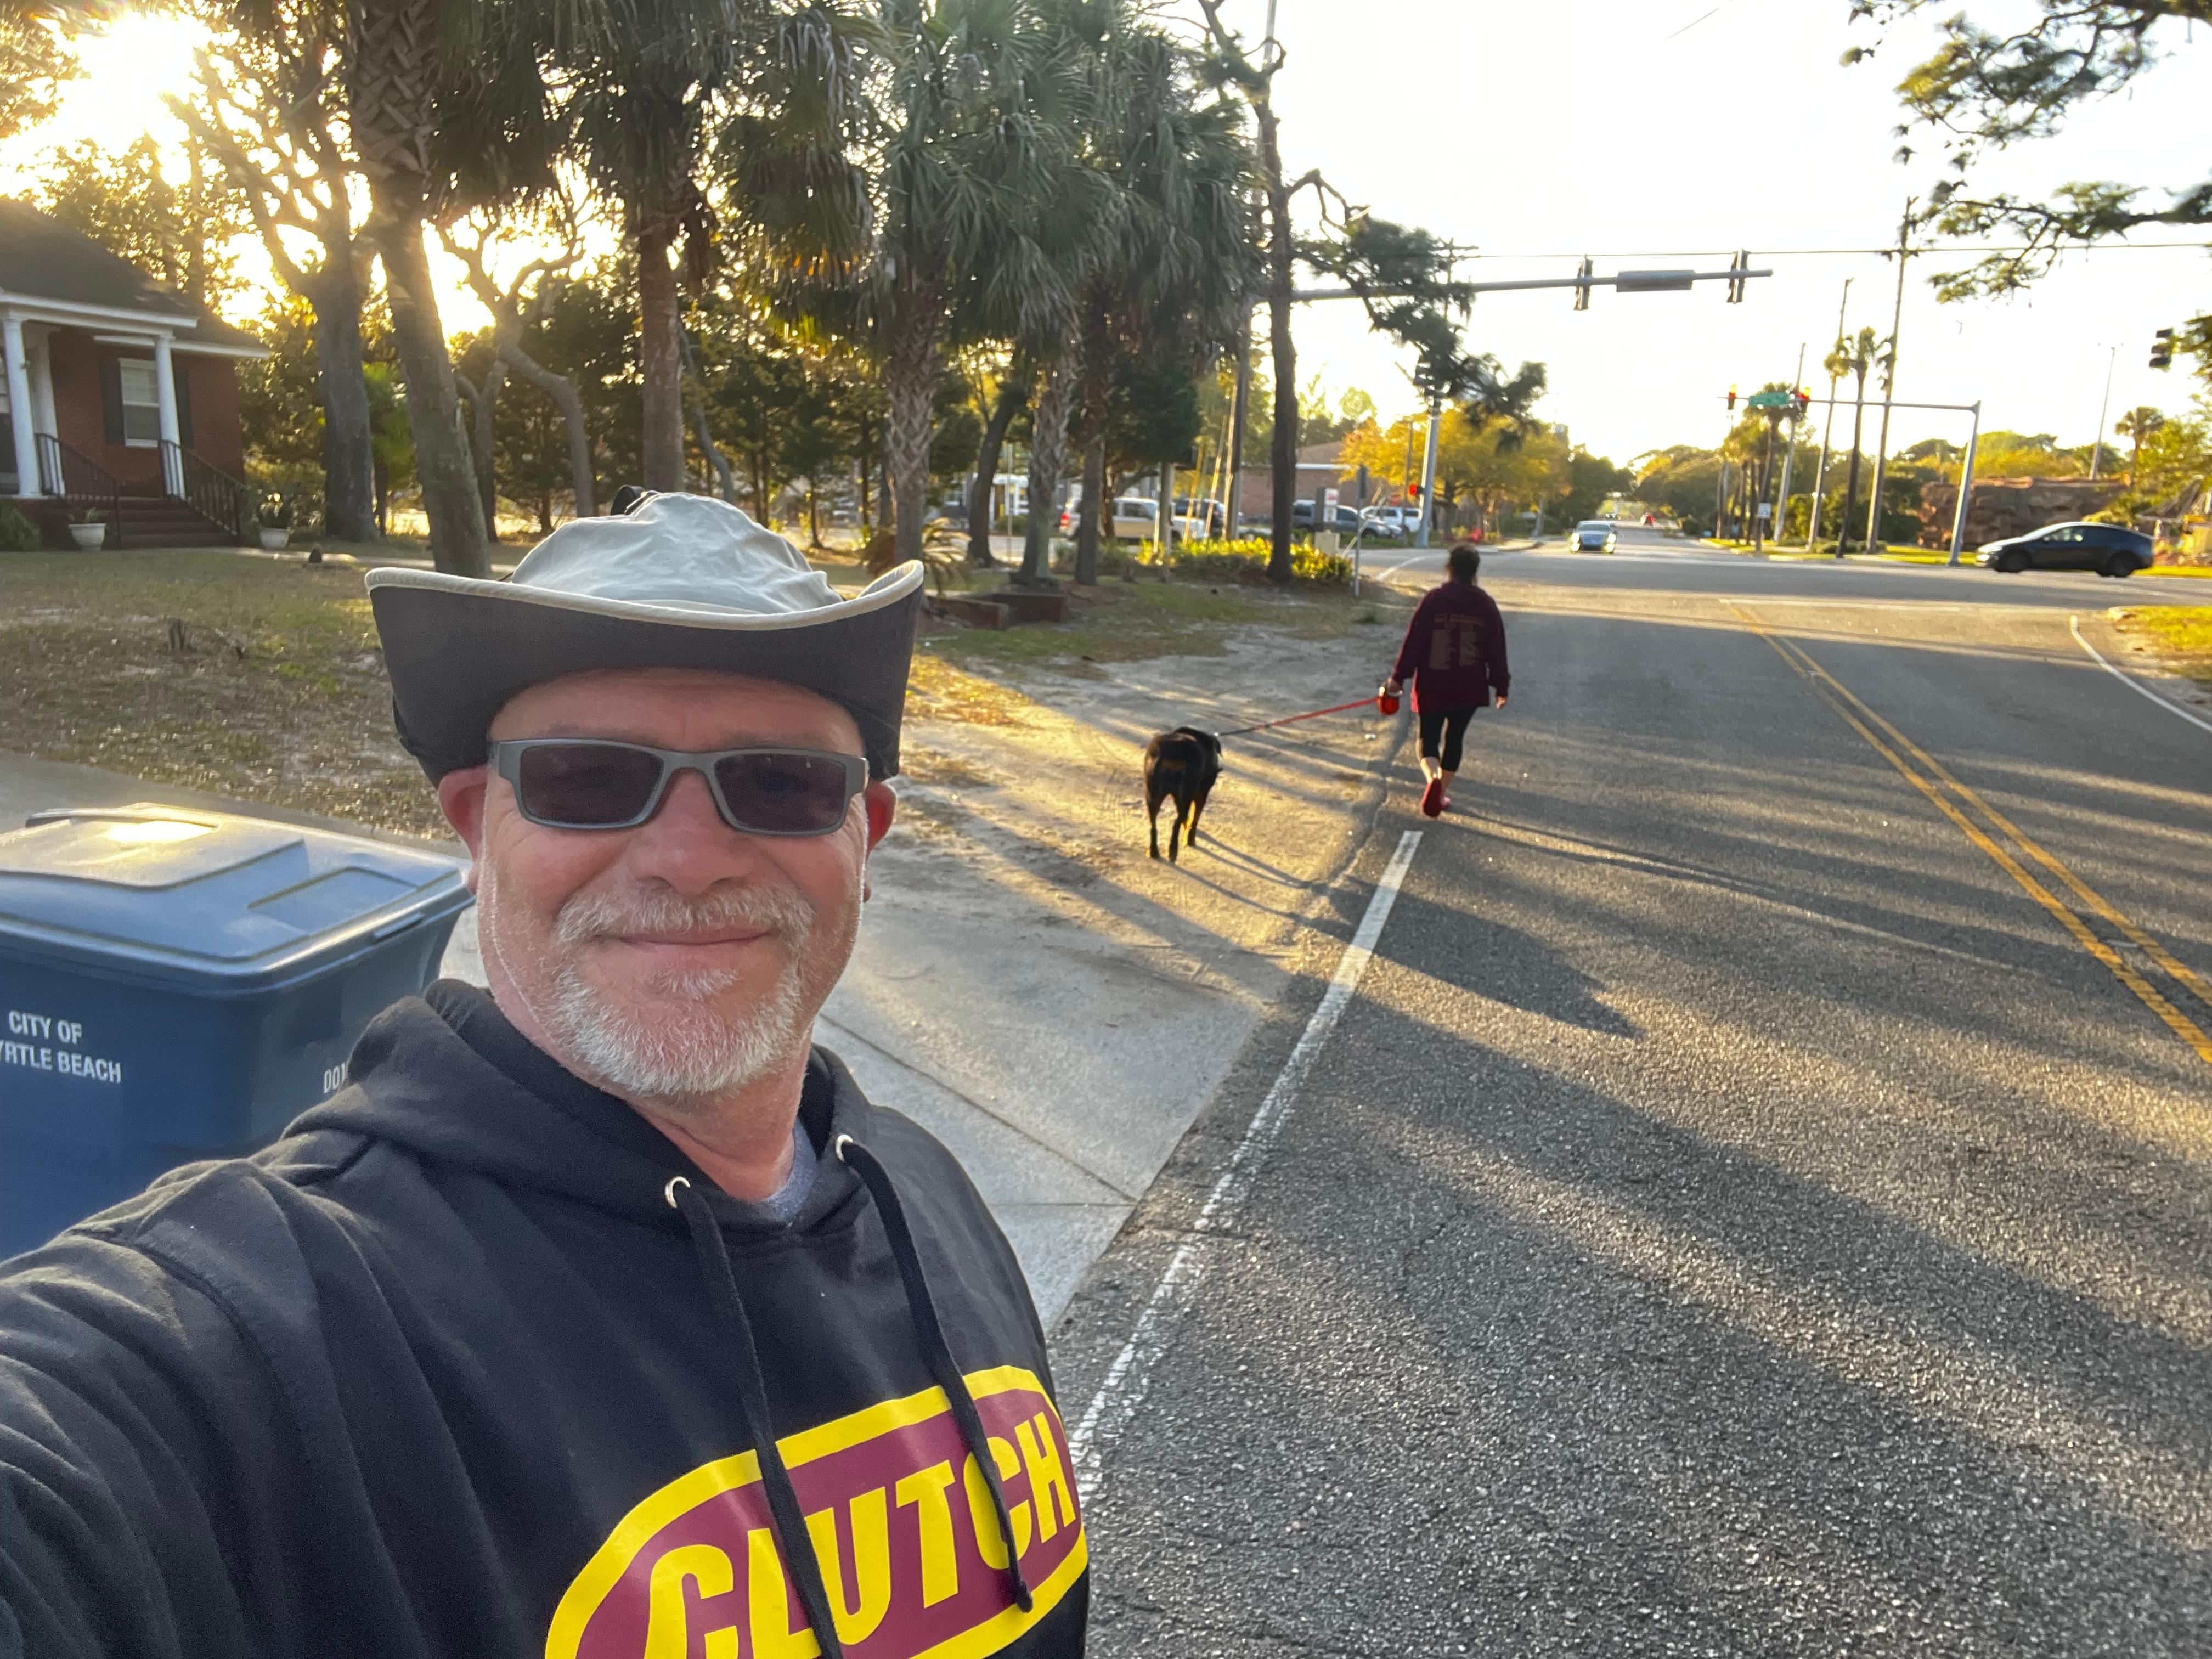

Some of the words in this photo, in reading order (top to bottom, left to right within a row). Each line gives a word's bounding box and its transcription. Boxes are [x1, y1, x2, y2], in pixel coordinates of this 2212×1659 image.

[8, 1010, 52, 1040] CITY
[57, 1020, 82, 1045] OF
[58, 1050, 121, 1084] BEACH
[643, 1412, 1077, 1659] CLUTCH
